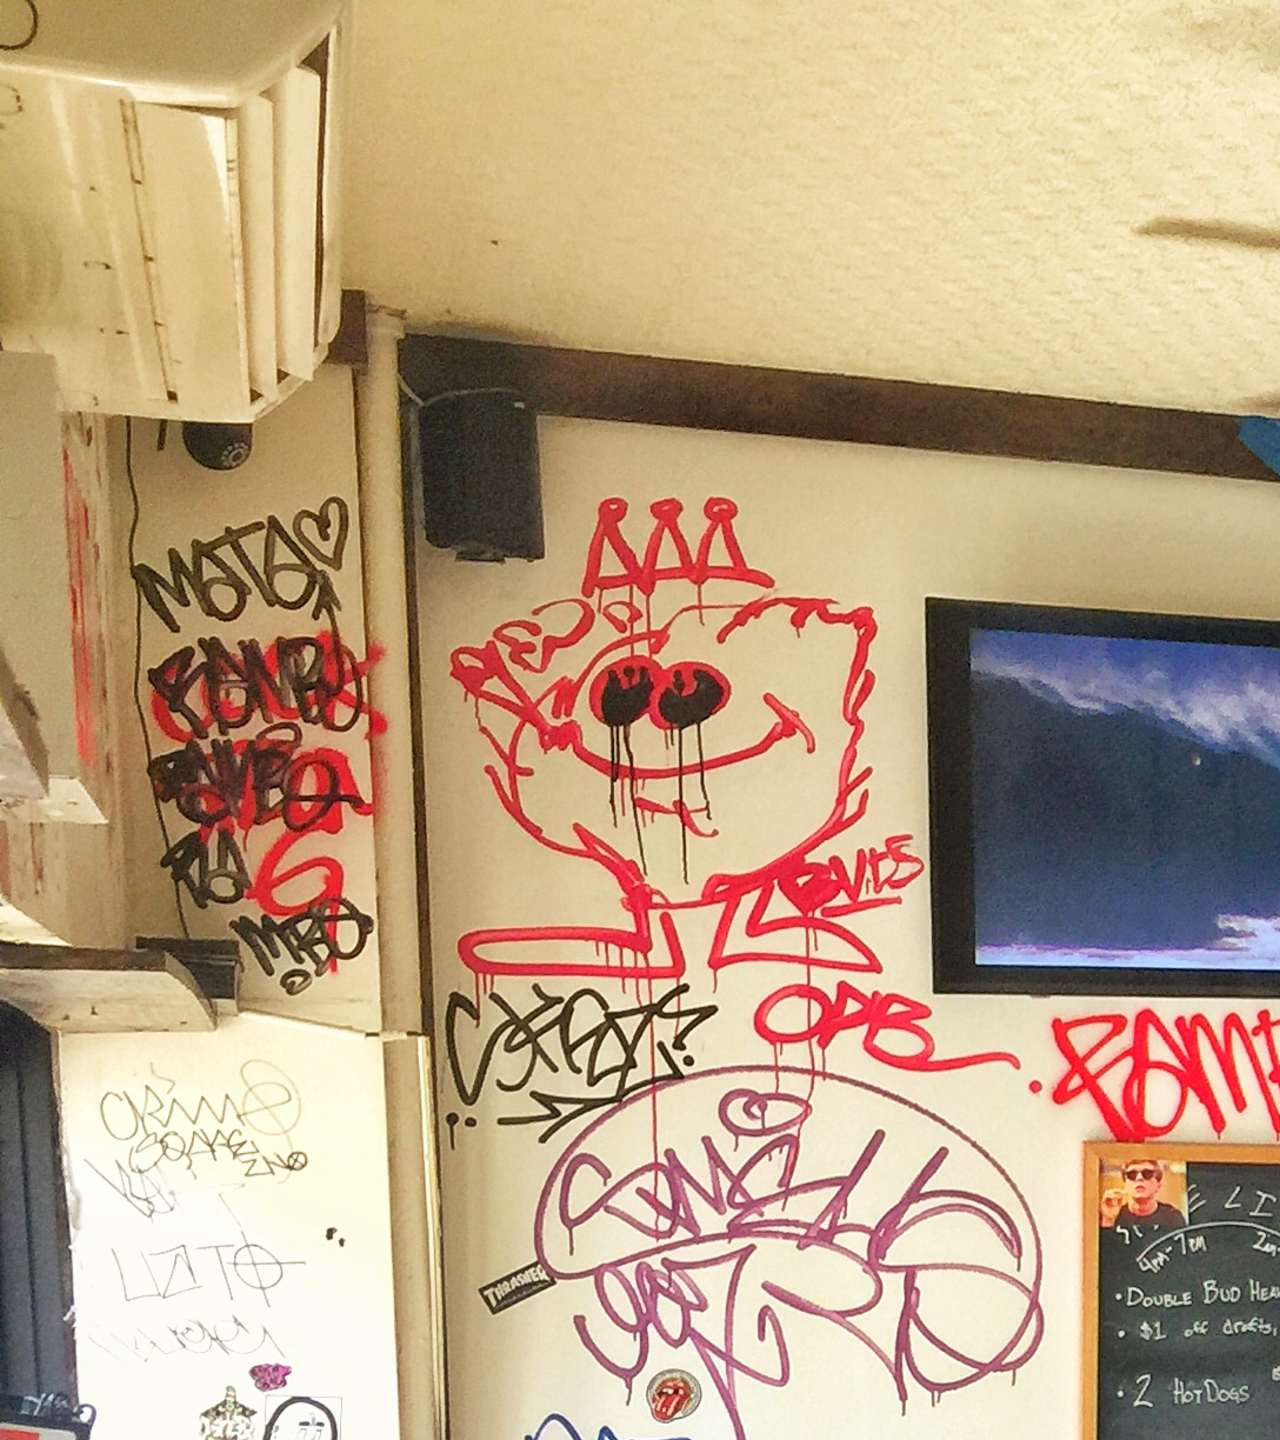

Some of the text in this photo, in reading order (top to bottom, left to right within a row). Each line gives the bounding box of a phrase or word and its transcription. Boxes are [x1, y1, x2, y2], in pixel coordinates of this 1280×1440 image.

[483, 1264, 550, 1307] THRASHER
[1126, 1287, 1193, 1307] DOUBLE
[1203, 1280, 1241, 1304] BUD
[1140, 1320, 1167, 1341] $1
[1184, 1320, 1208, 1338] off
[1132, 1374, 1154, 1408] 2
